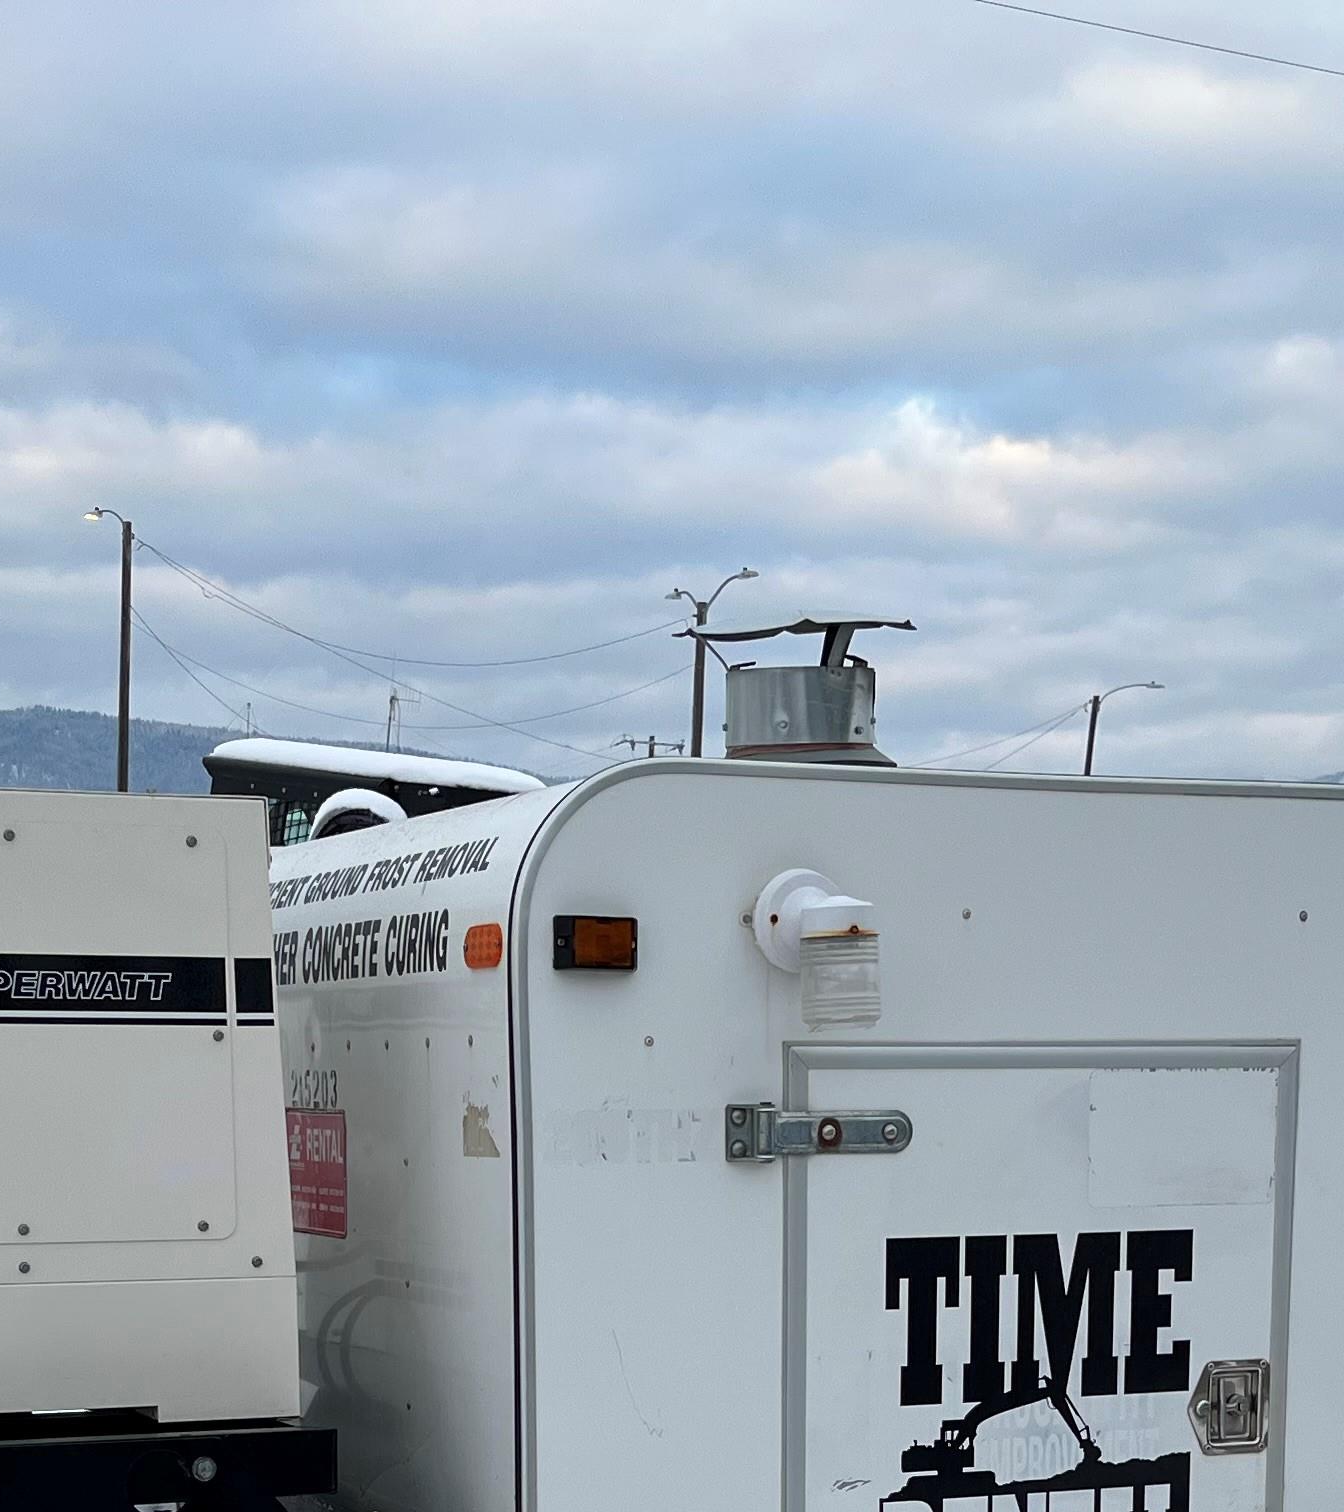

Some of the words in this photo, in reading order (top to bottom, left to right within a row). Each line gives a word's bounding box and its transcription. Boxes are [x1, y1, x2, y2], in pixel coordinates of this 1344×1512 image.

[303, 863, 369, 905] GROUND
[362, 852, 423, 894] FROST
[413, 835, 500, 885] REMOVAL
[302, 918, 383, 985] CONCRETE
[384, 908, 450, 977] CURING
[306, 1127, 344, 1165] RENTAL
[884, 1228, 1194, 1407] TIME
